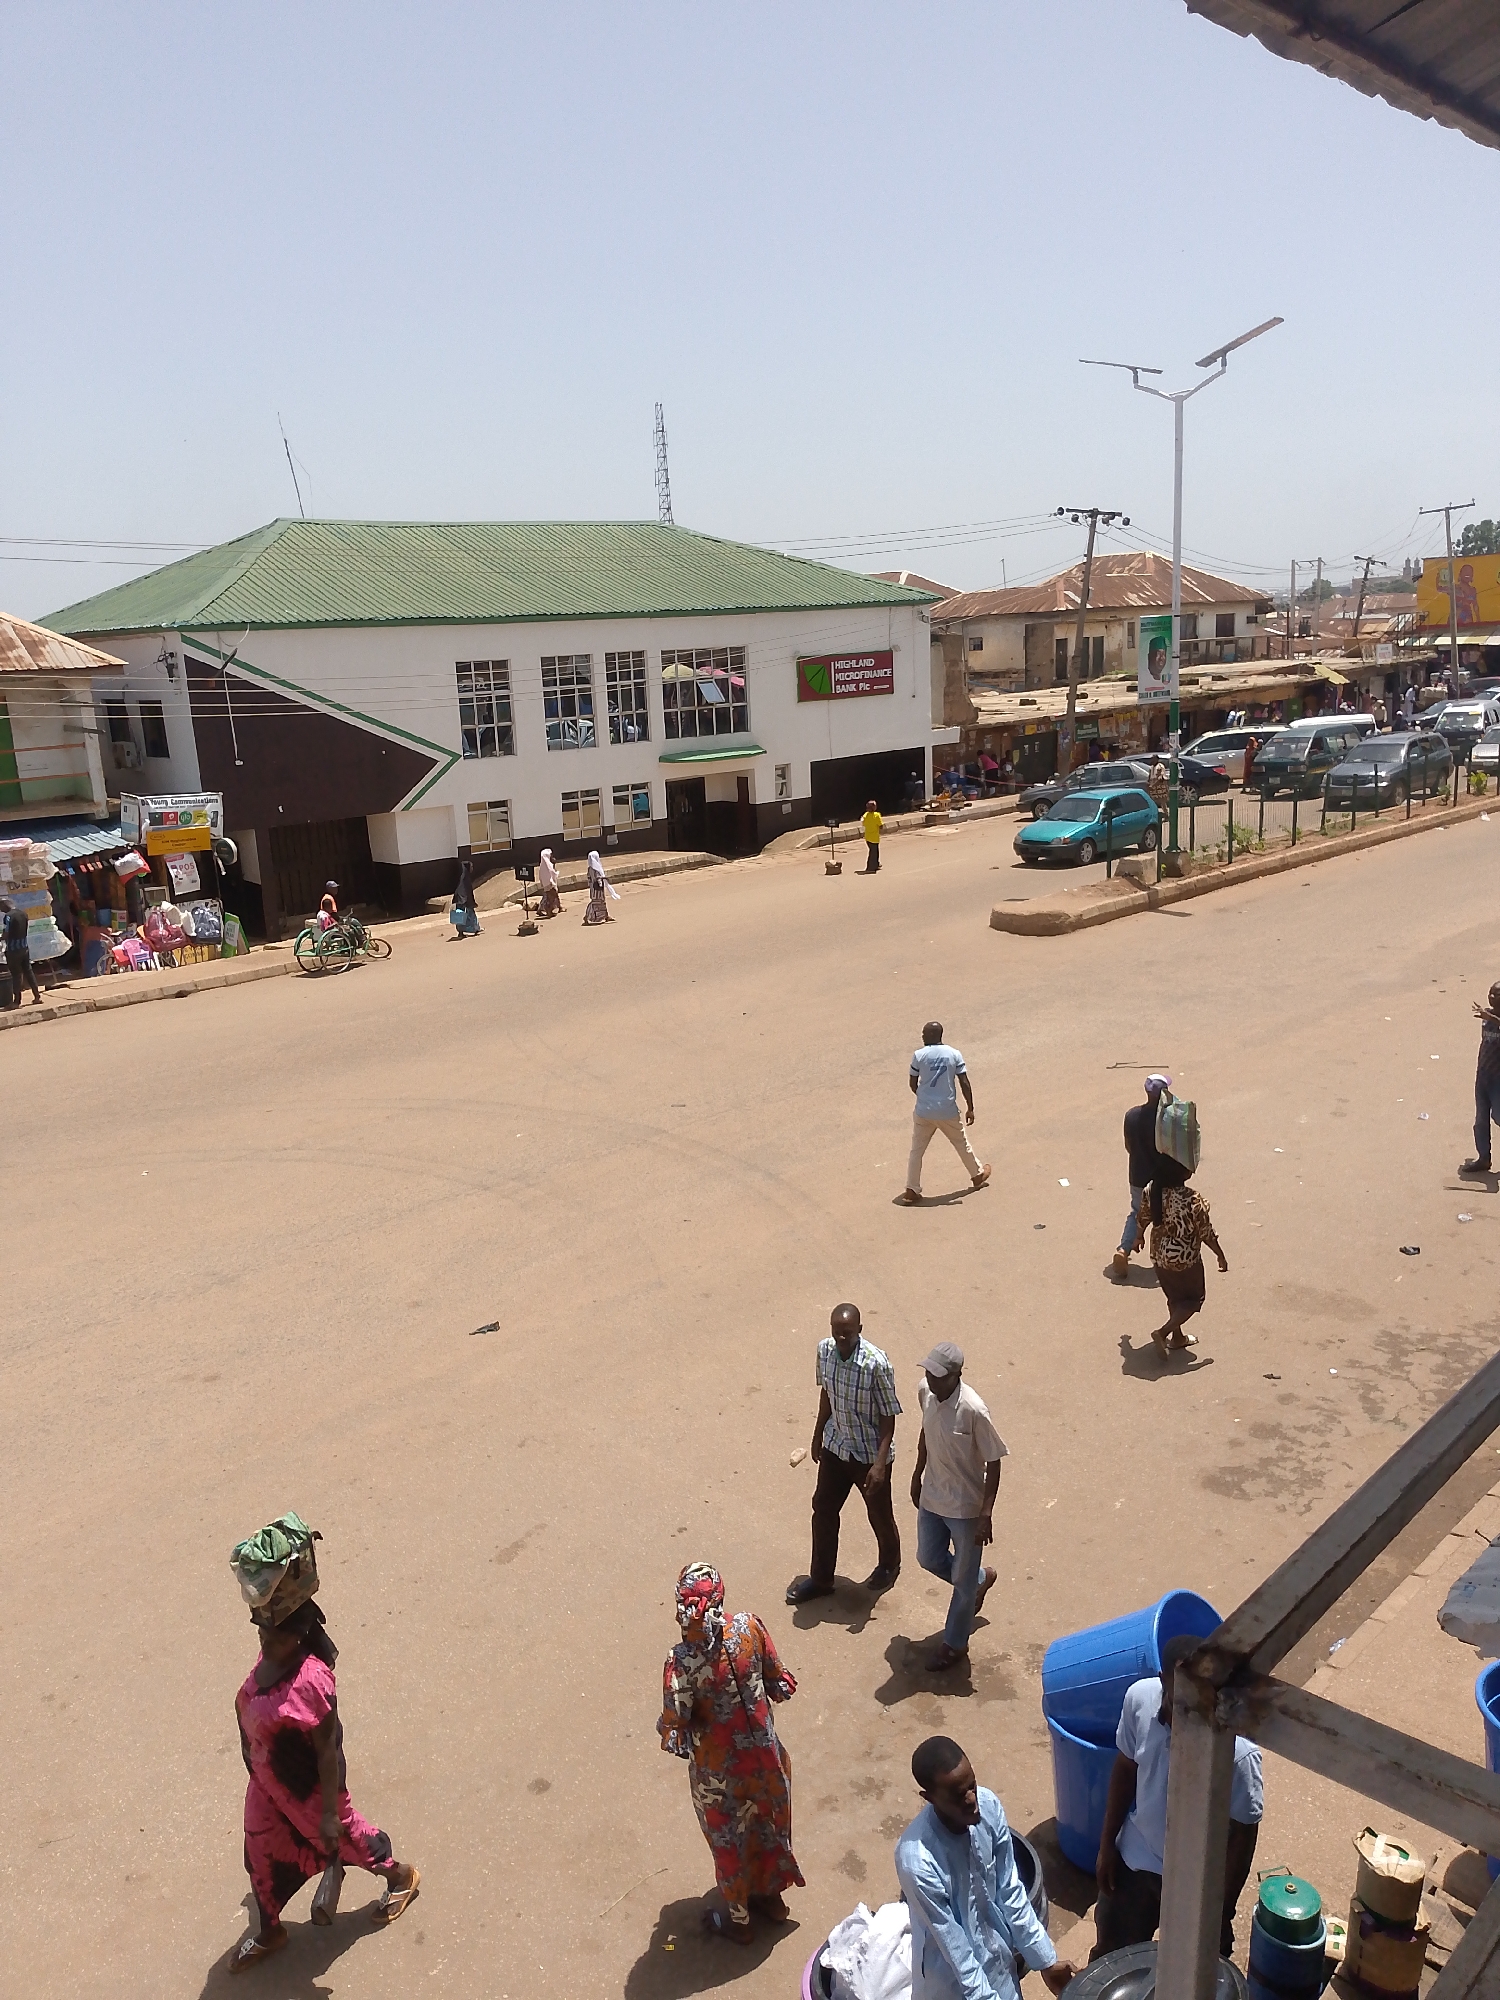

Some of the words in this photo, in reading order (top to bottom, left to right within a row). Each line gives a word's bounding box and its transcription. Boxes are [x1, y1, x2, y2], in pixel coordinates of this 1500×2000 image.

[835, 658, 875, 670] HIGHLAND
[835, 668, 893, 681] MICROFINANCE
[835, 683, 857, 693] BANK
[859, 682, 870, 691] Plc
[178, 862, 195, 871] POS
[929, 1065, 948, 1088] 7
